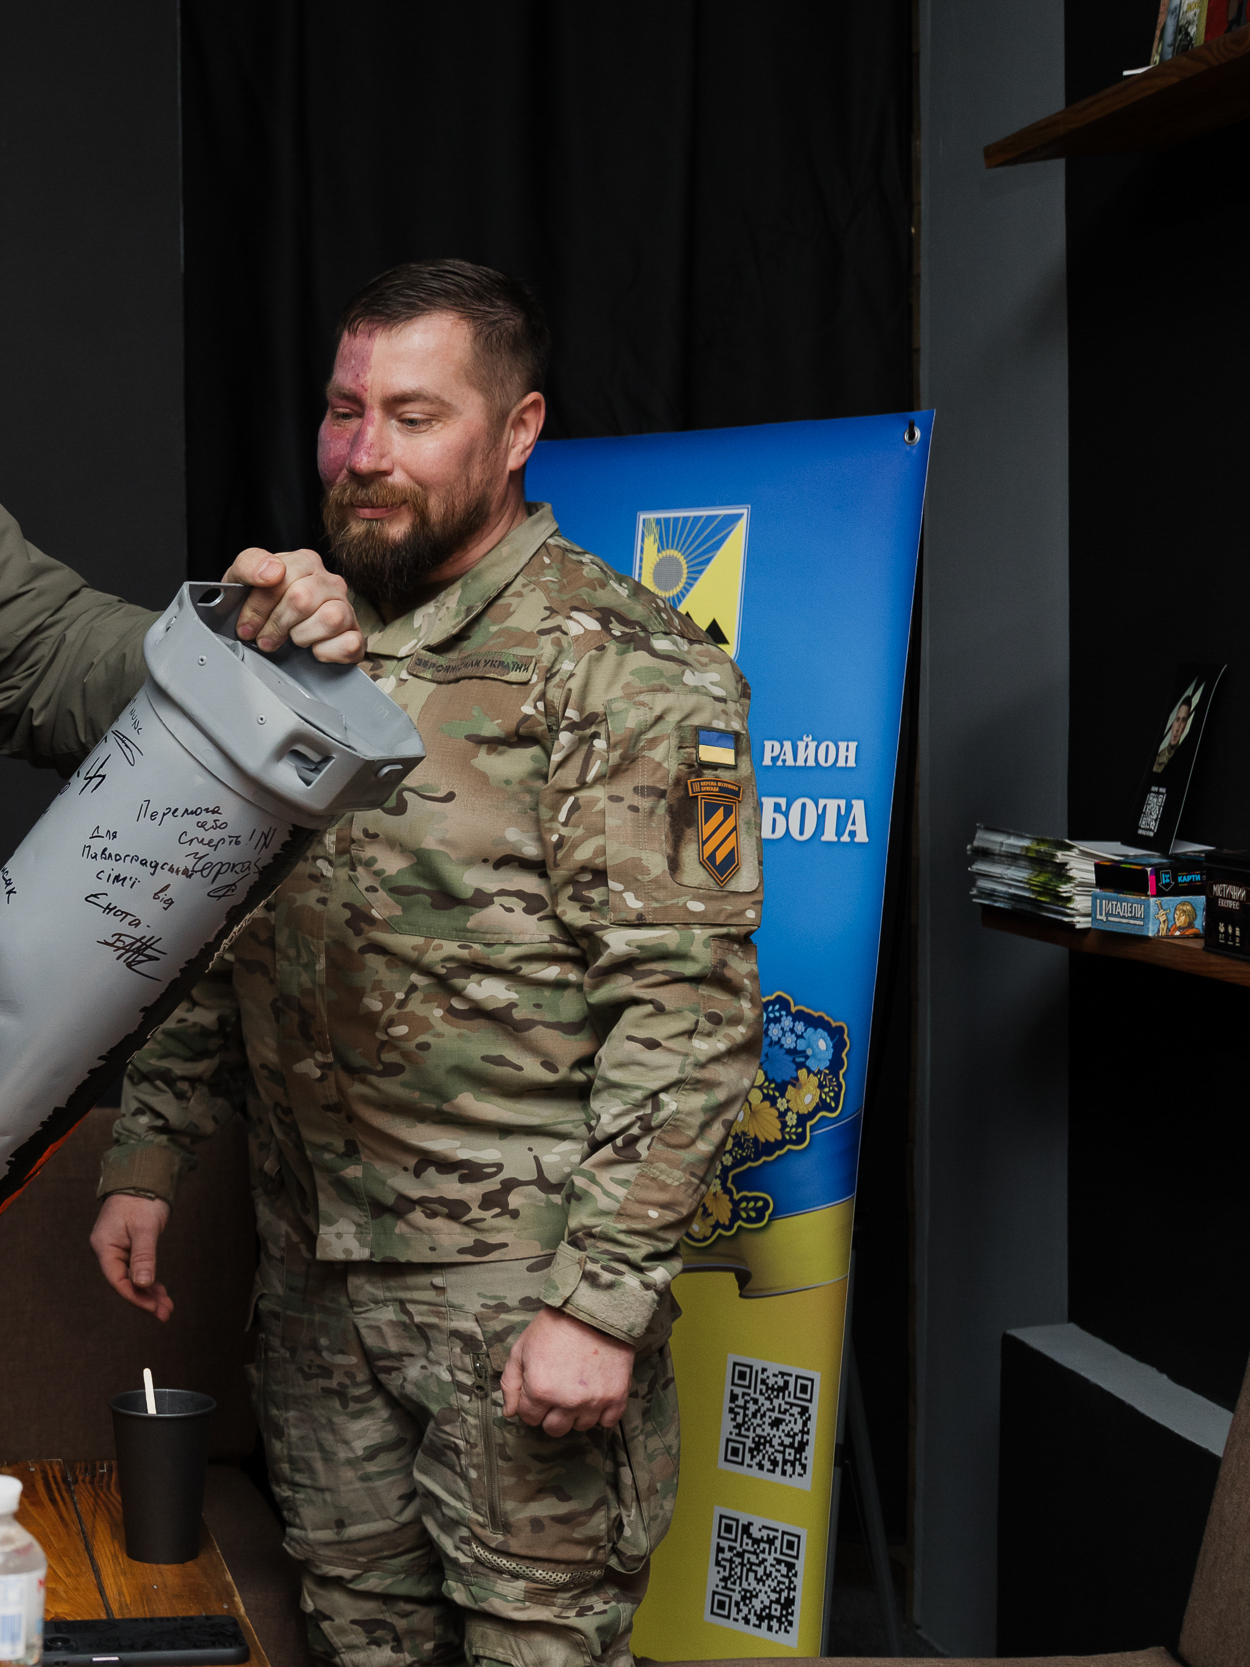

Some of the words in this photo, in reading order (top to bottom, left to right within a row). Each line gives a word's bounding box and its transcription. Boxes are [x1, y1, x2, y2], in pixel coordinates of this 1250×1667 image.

[482, 658, 530, 674] УКРАЇНИ
[762, 733, 858, 768] РАЙОН
[136, 799, 223, 826] Перемога
[761, 796, 869, 843] БОТА
[89, 825, 118, 841] Для
[1177, 873, 1201, 883] КАРТИ
[153, 883, 176, 911] від
